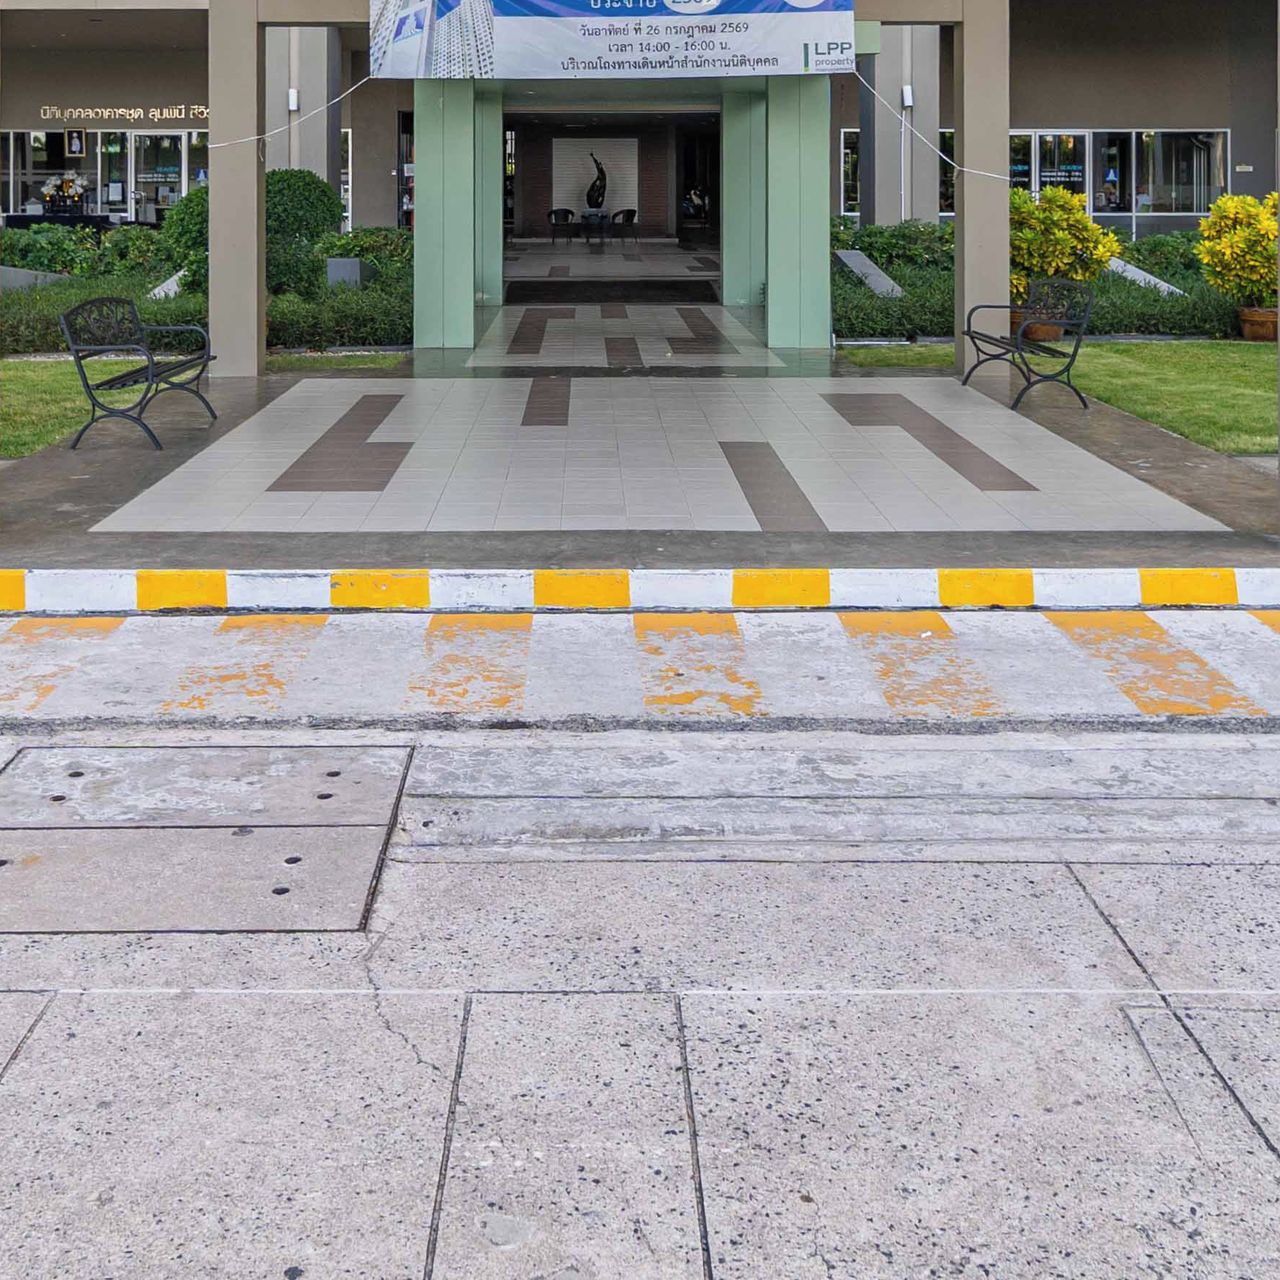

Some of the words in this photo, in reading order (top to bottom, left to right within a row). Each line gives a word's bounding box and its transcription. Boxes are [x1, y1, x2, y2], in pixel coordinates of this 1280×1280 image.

[580, 21, 629, 37] วันอาทิตย์
[633, 20, 642, 36] ที่
[646, 24, 660, 35] 26
[665, 23, 716, 38] กรกฎาคม
[720, 22, 749, 34] 2569
[608, 41, 633, 53] เวลา
[638, 41, 671, 53] 14:00
[684, 41, 716, 52] 16:00
[719, 41, 731, 51] น.
[814, 42, 852, 55] LPP
[561, 54, 779, 72] บริเวณโถงทางเดินหน้าสำนักงานนิติบุคคล
[815, 57, 854, 68] property
[40, 105, 144, 122] นิติบุคคลอาคารชุด
[149, 104, 186, 122] ลุมพินี
